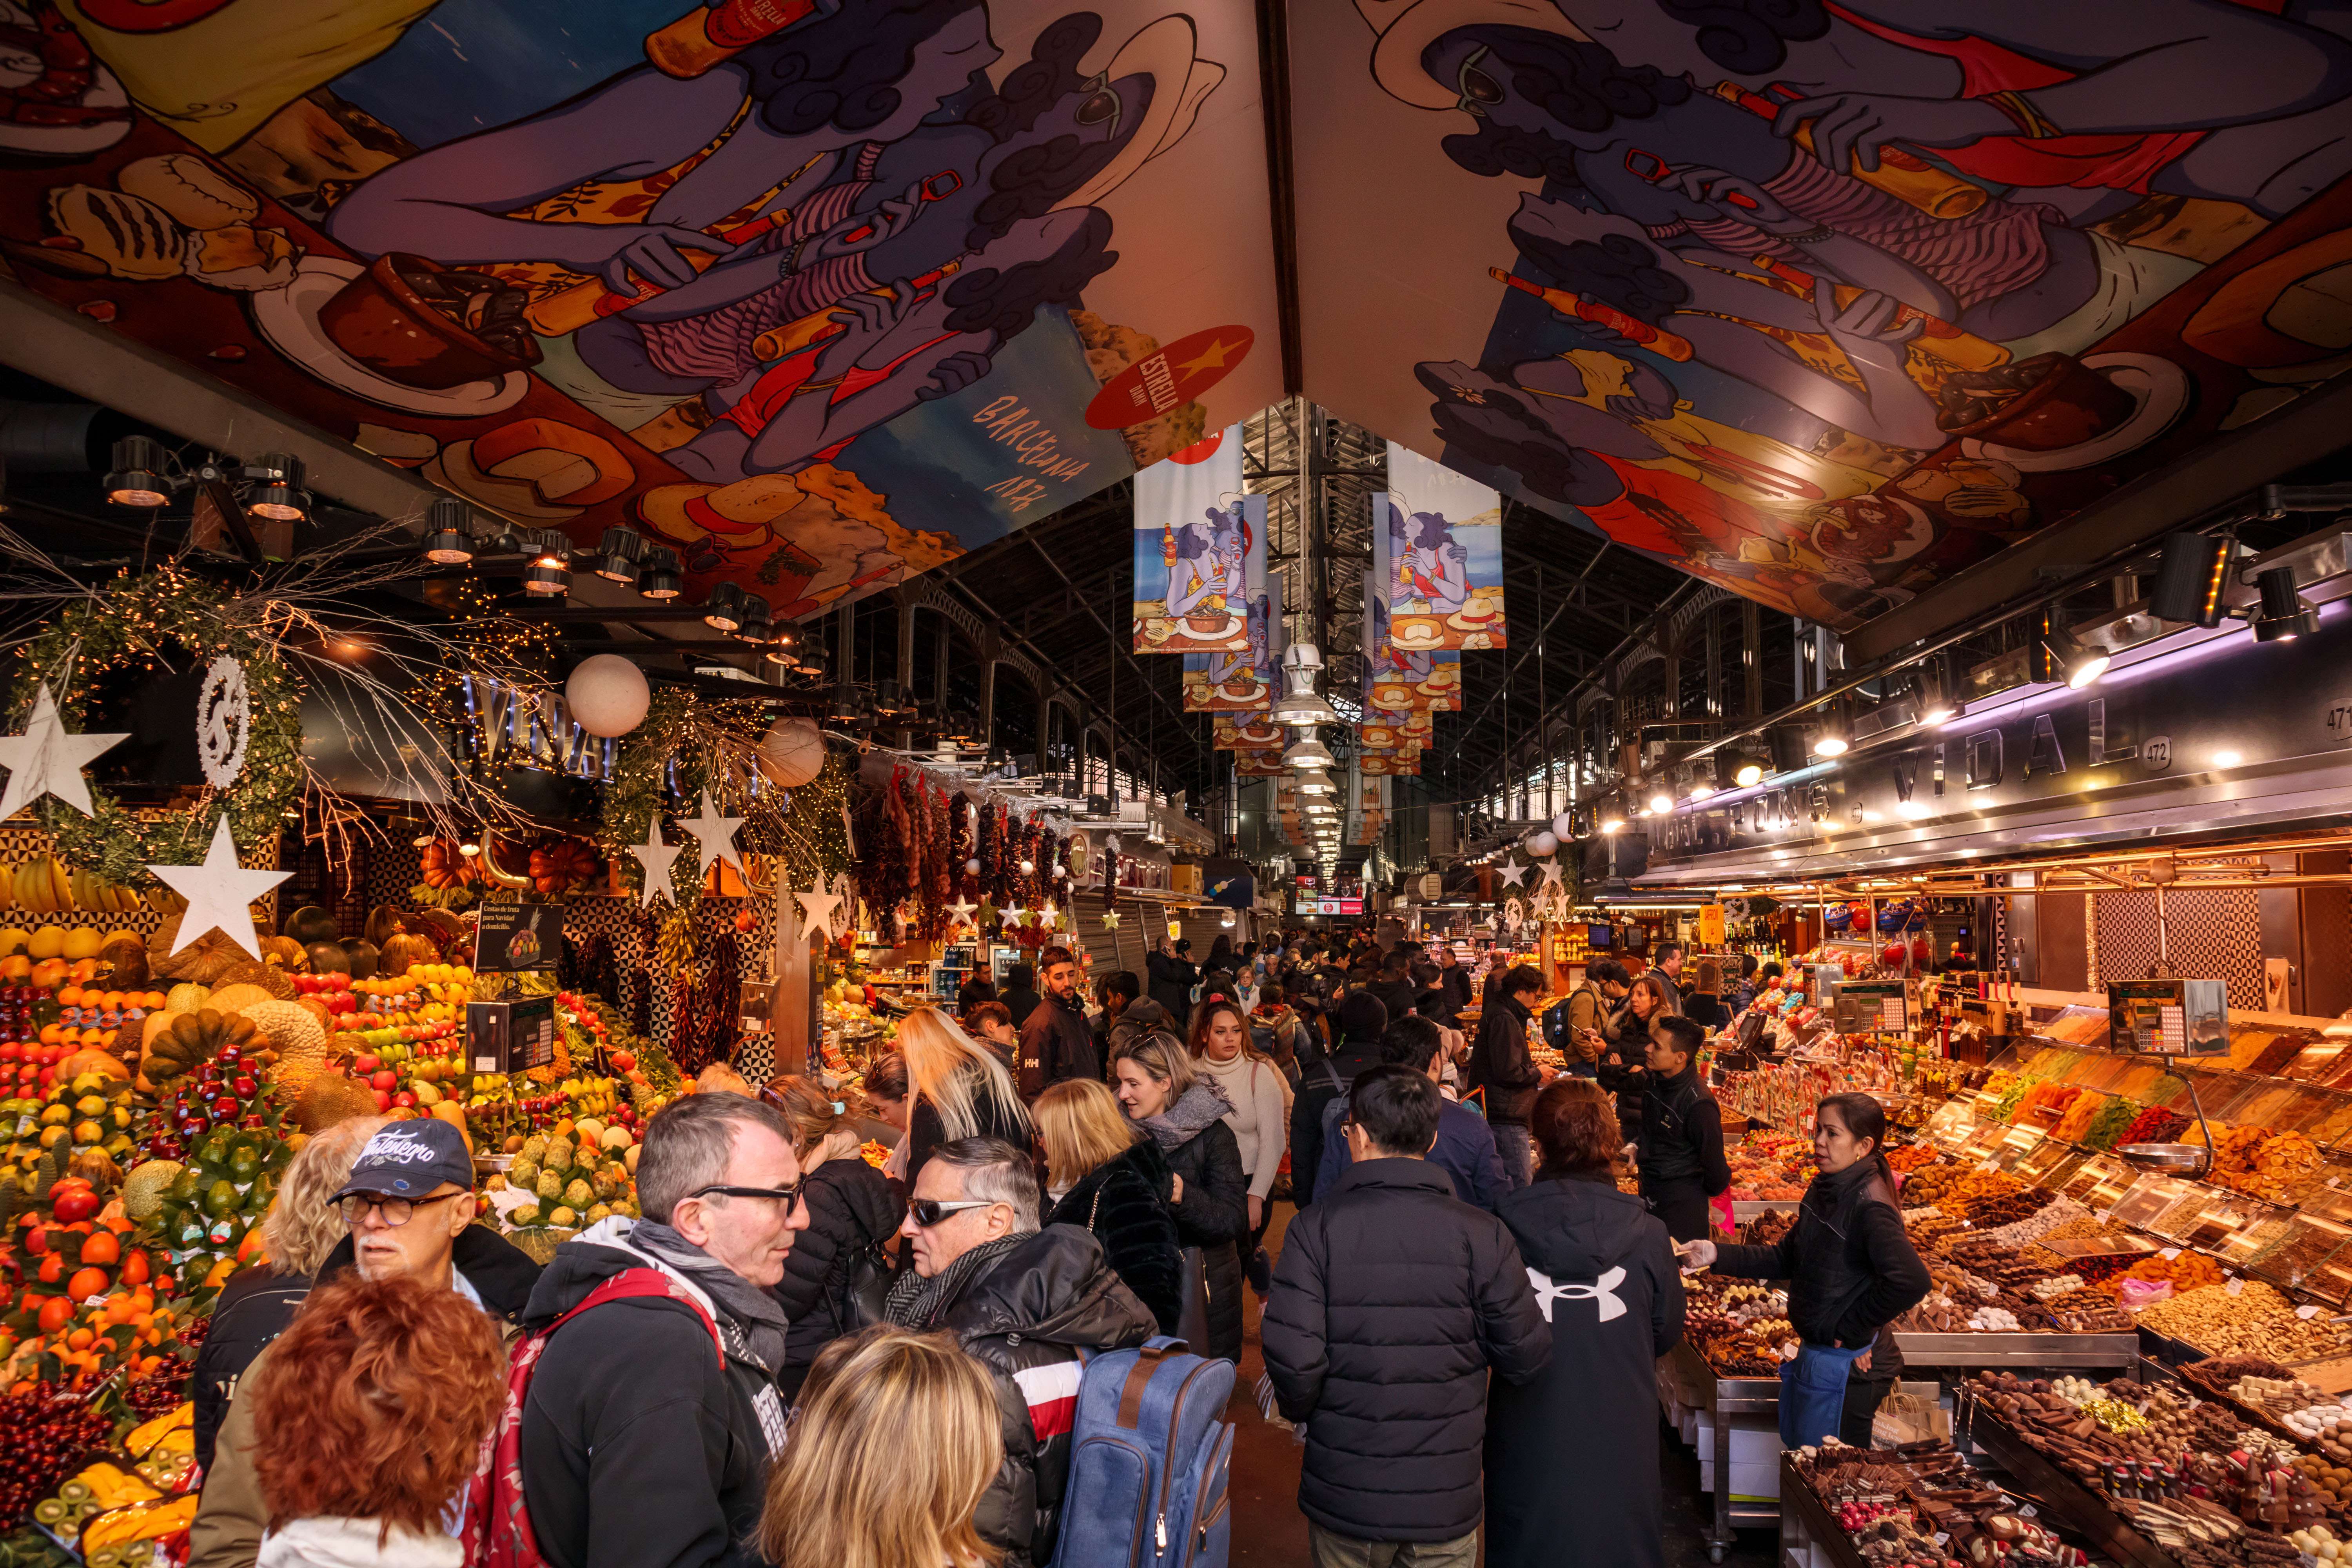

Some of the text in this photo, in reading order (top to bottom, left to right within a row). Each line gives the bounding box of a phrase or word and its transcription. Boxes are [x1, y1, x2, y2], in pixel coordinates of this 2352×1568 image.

[1129, 385, 1148, 407] DAMM
[1138, 352, 1180, 414] ESTRELLA
[973, 395, 1091, 482] BARCELONA
[984, 475, 1049, 512] 1876
[1730, 778, 1829, 839] PONS
[1892, 698, 2138, 803] VIDAL
[2147, 743, 2166, 763] 472
[2327, 706, 2352, 730] 471
[1024, 1058, 1039, 1068] HH
